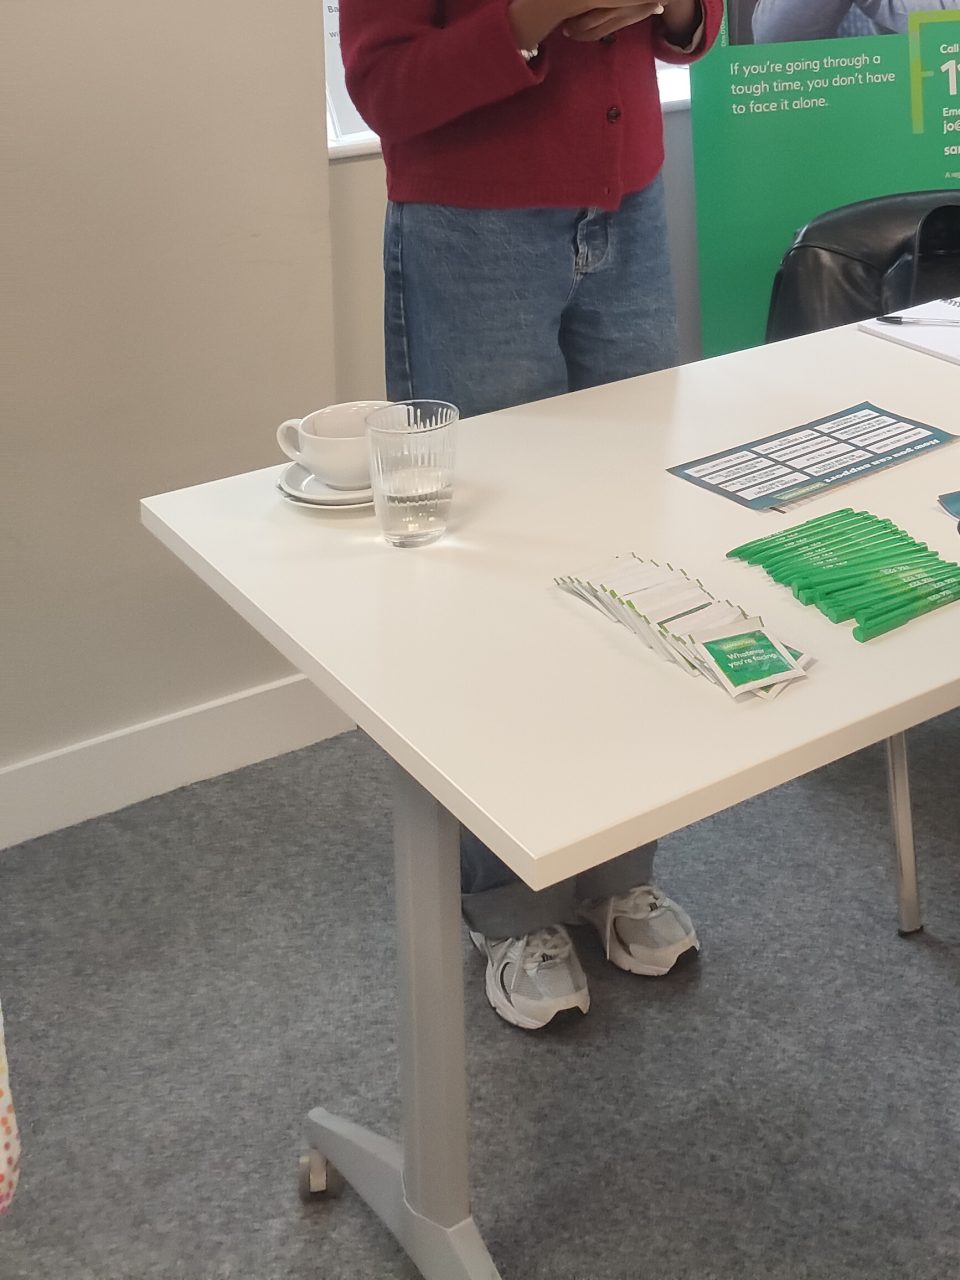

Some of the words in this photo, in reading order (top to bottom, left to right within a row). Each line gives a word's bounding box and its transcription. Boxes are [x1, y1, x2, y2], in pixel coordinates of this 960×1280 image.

[940, 43, 959, 54] Call
[730, 62, 739, 75] If
[742, 61, 782, 77] you're
[785, 58, 820, 74] going
[823, 54, 870, 69] through
[872, 55, 881, 64] a
[730, 80, 769, 96] tough
[773, 79, 804, 92] time,
[807, 78, 829, 92] you
[832, 73, 863, 86] don't
[866, 72, 896, 84] have
[732, 103, 746, 114] to
[750, 100, 777, 113] face
[780, 99, 789, 110] it
[792, 97, 828, 109] alone.
[914, 438, 941, 451] How
[893, 447, 915, 458] you
[871, 456, 893, 466] can
[824, 463, 872, 483] support
